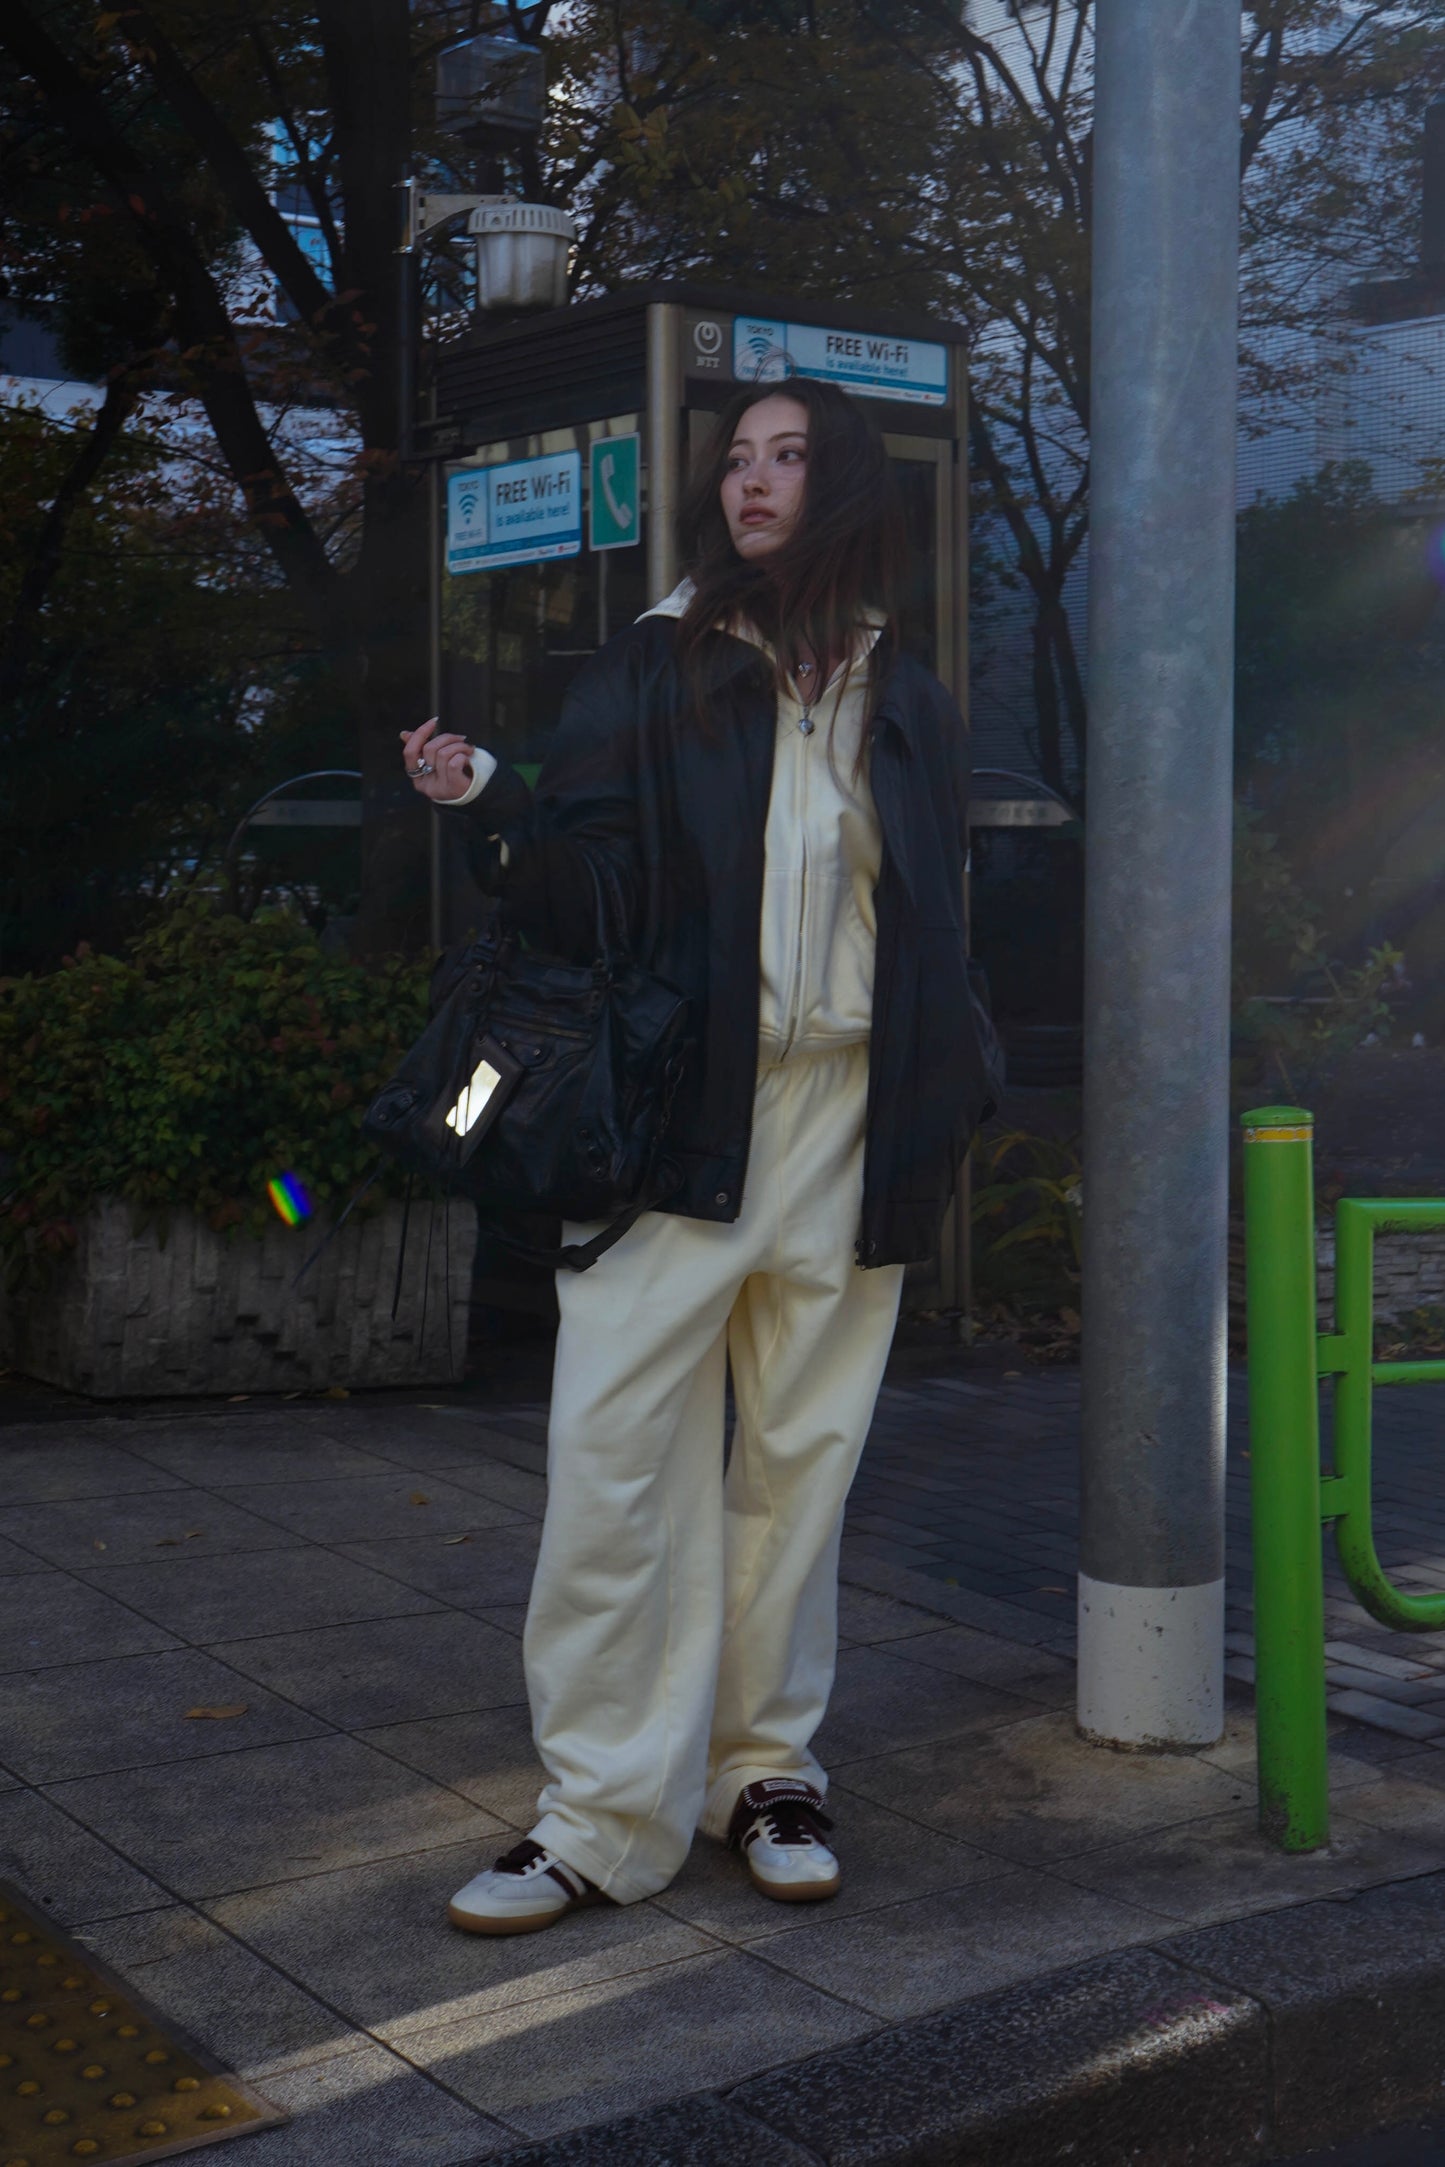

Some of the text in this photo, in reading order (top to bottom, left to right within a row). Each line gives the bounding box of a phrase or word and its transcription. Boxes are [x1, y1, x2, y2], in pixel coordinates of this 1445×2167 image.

[746, 324, 774, 336] TOKYO
[827, 335, 909, 363] FREE Wi-Fi
[696, 355, 720, 368] NTT
[826, 356, 909, 378] is available here!
[496, 470, 571, 506] FREE Wi-Fi
[496, 501, 570, 527] is available here!
